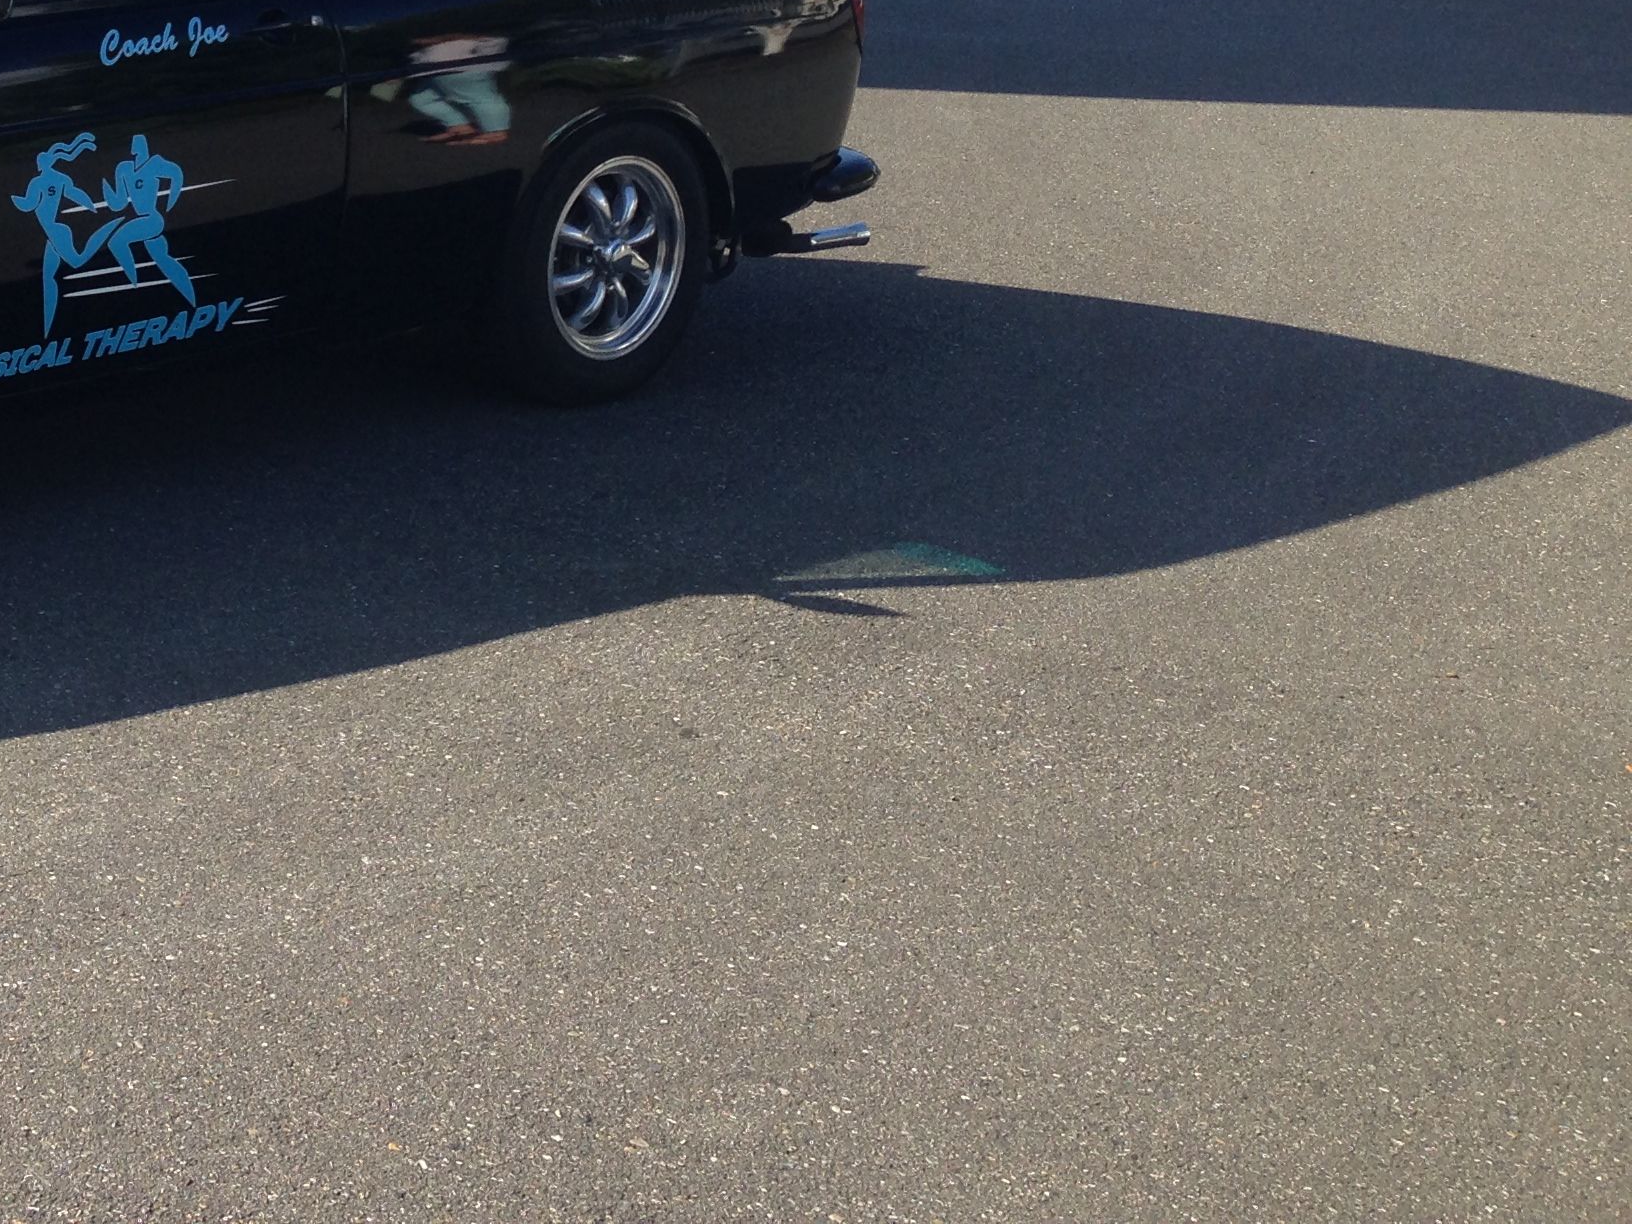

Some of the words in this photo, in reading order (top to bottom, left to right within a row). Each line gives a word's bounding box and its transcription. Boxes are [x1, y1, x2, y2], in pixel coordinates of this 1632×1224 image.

[99, 22, 178, 66] Coach
[188, 16, 229, 58] Joe
[46, 185, 57, 197] S
[134, 179, 144, 190] C
[81, 297, 245, 362] THERAPY
